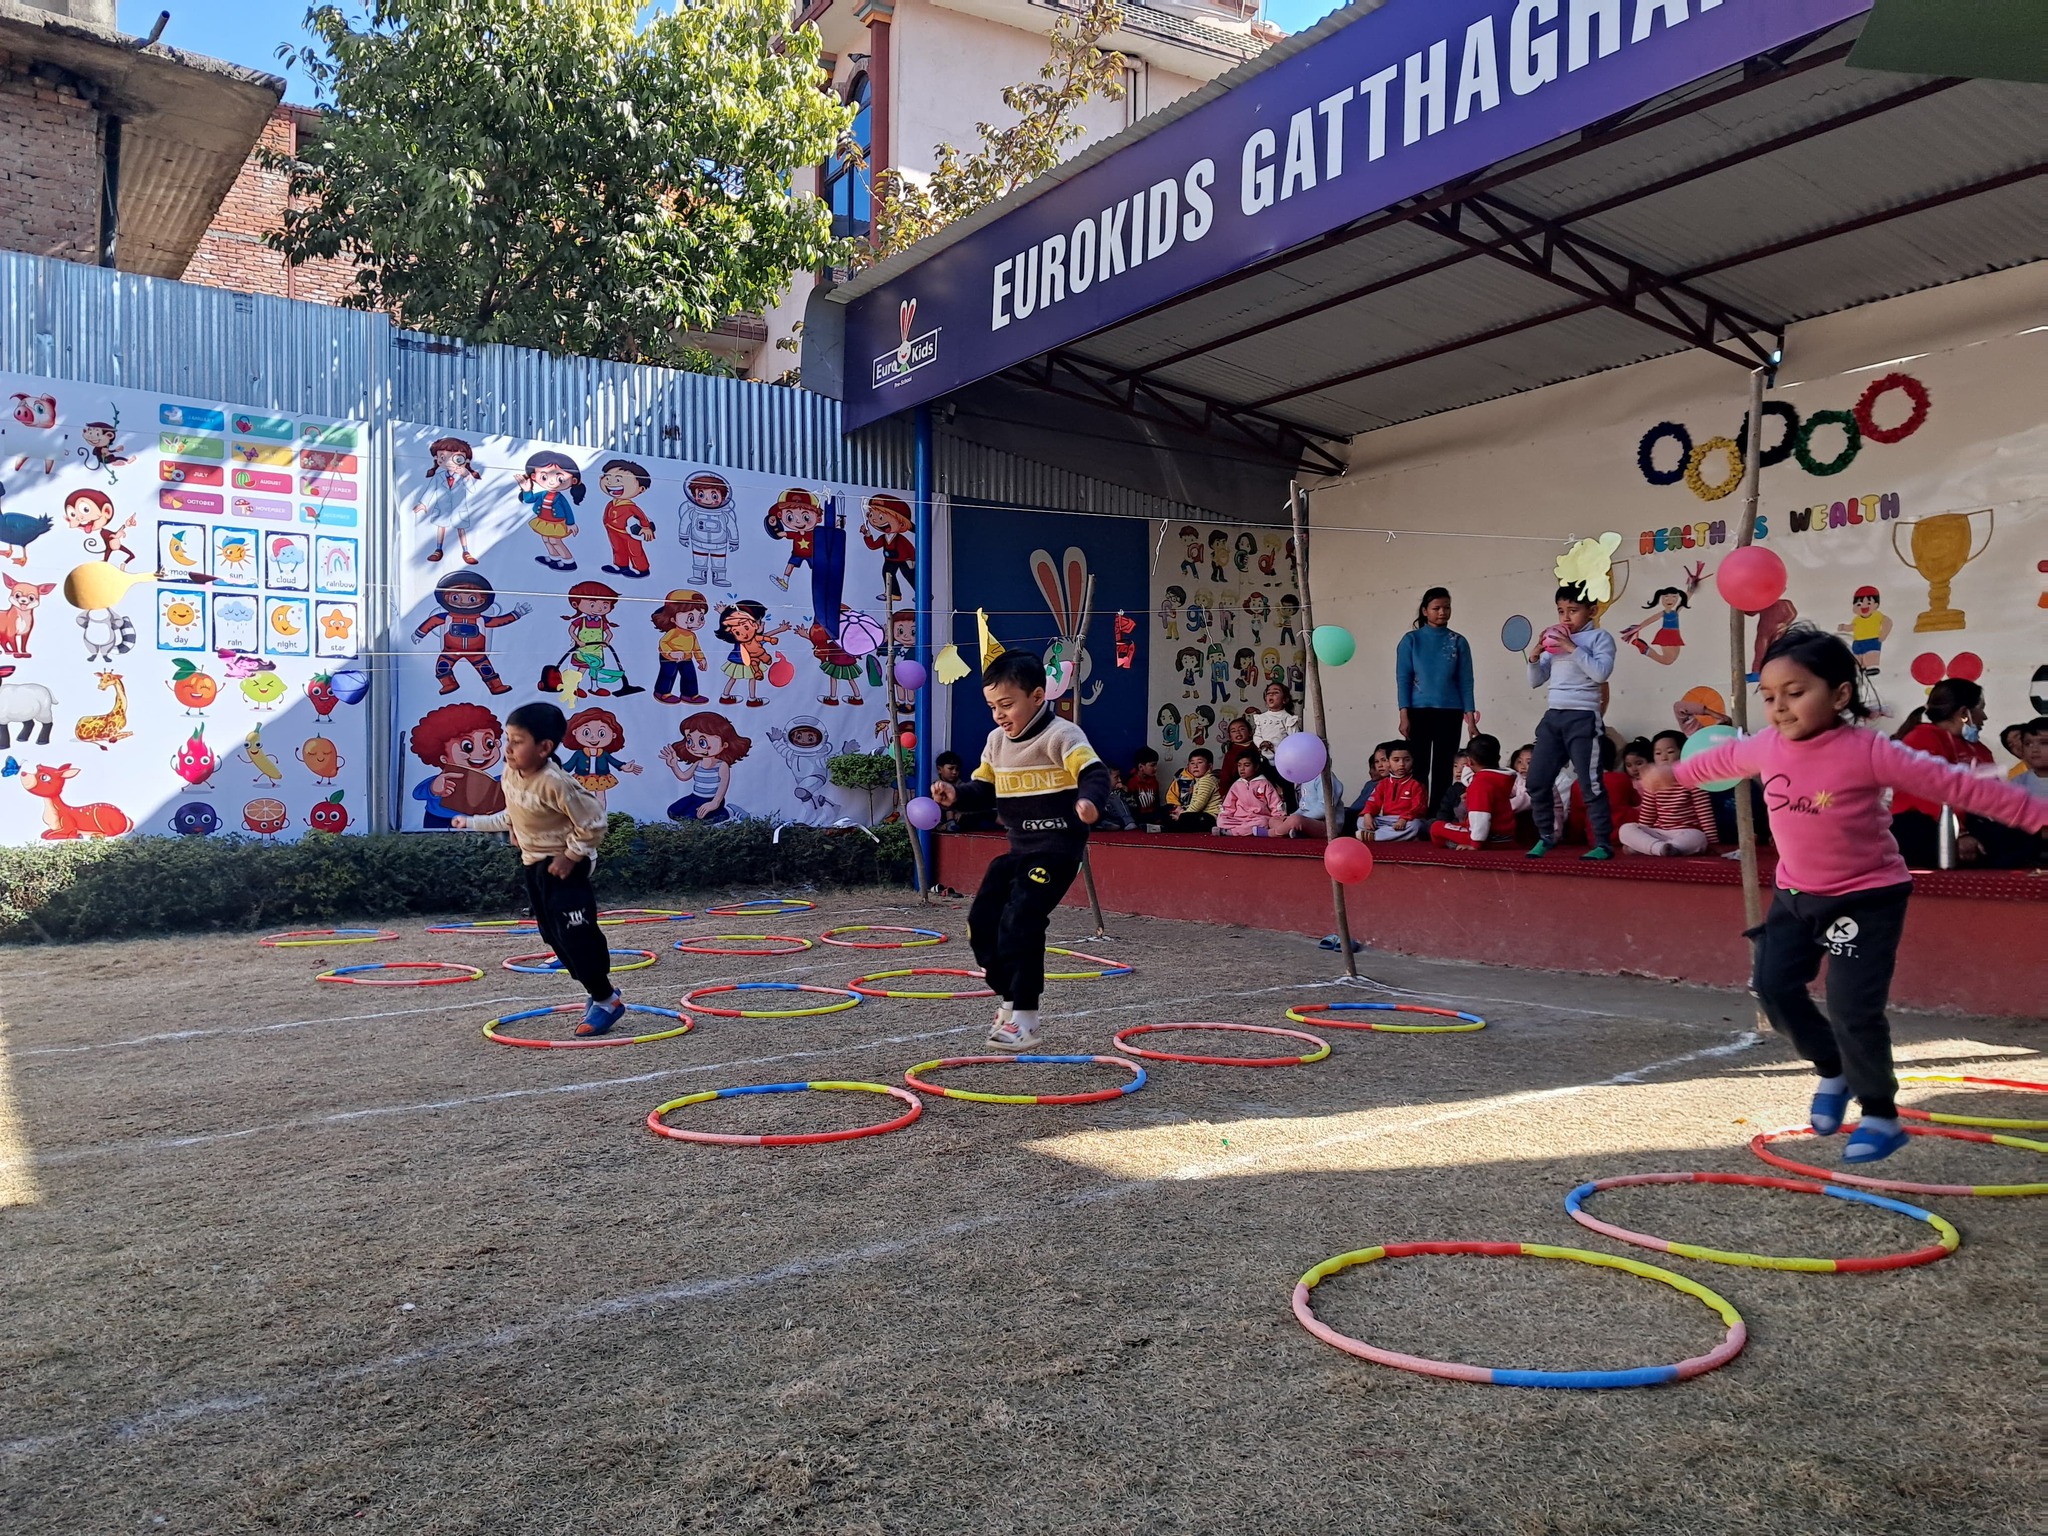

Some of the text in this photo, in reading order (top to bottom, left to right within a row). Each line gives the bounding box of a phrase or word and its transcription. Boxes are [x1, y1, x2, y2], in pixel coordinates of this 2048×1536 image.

[990, 157, 1215, 332] EUROKIDS
[911, 341, 934, 363] Kids
[1639, 519, 1726, 555] HEALTH
[1789, 492, 1900, 533] WEALTH
[276, 576, 296, 584] cloud
[326, 581, 355, 589] rainbow
[174, 636, 189, 645] day
[277, 640, 298, 649] night
